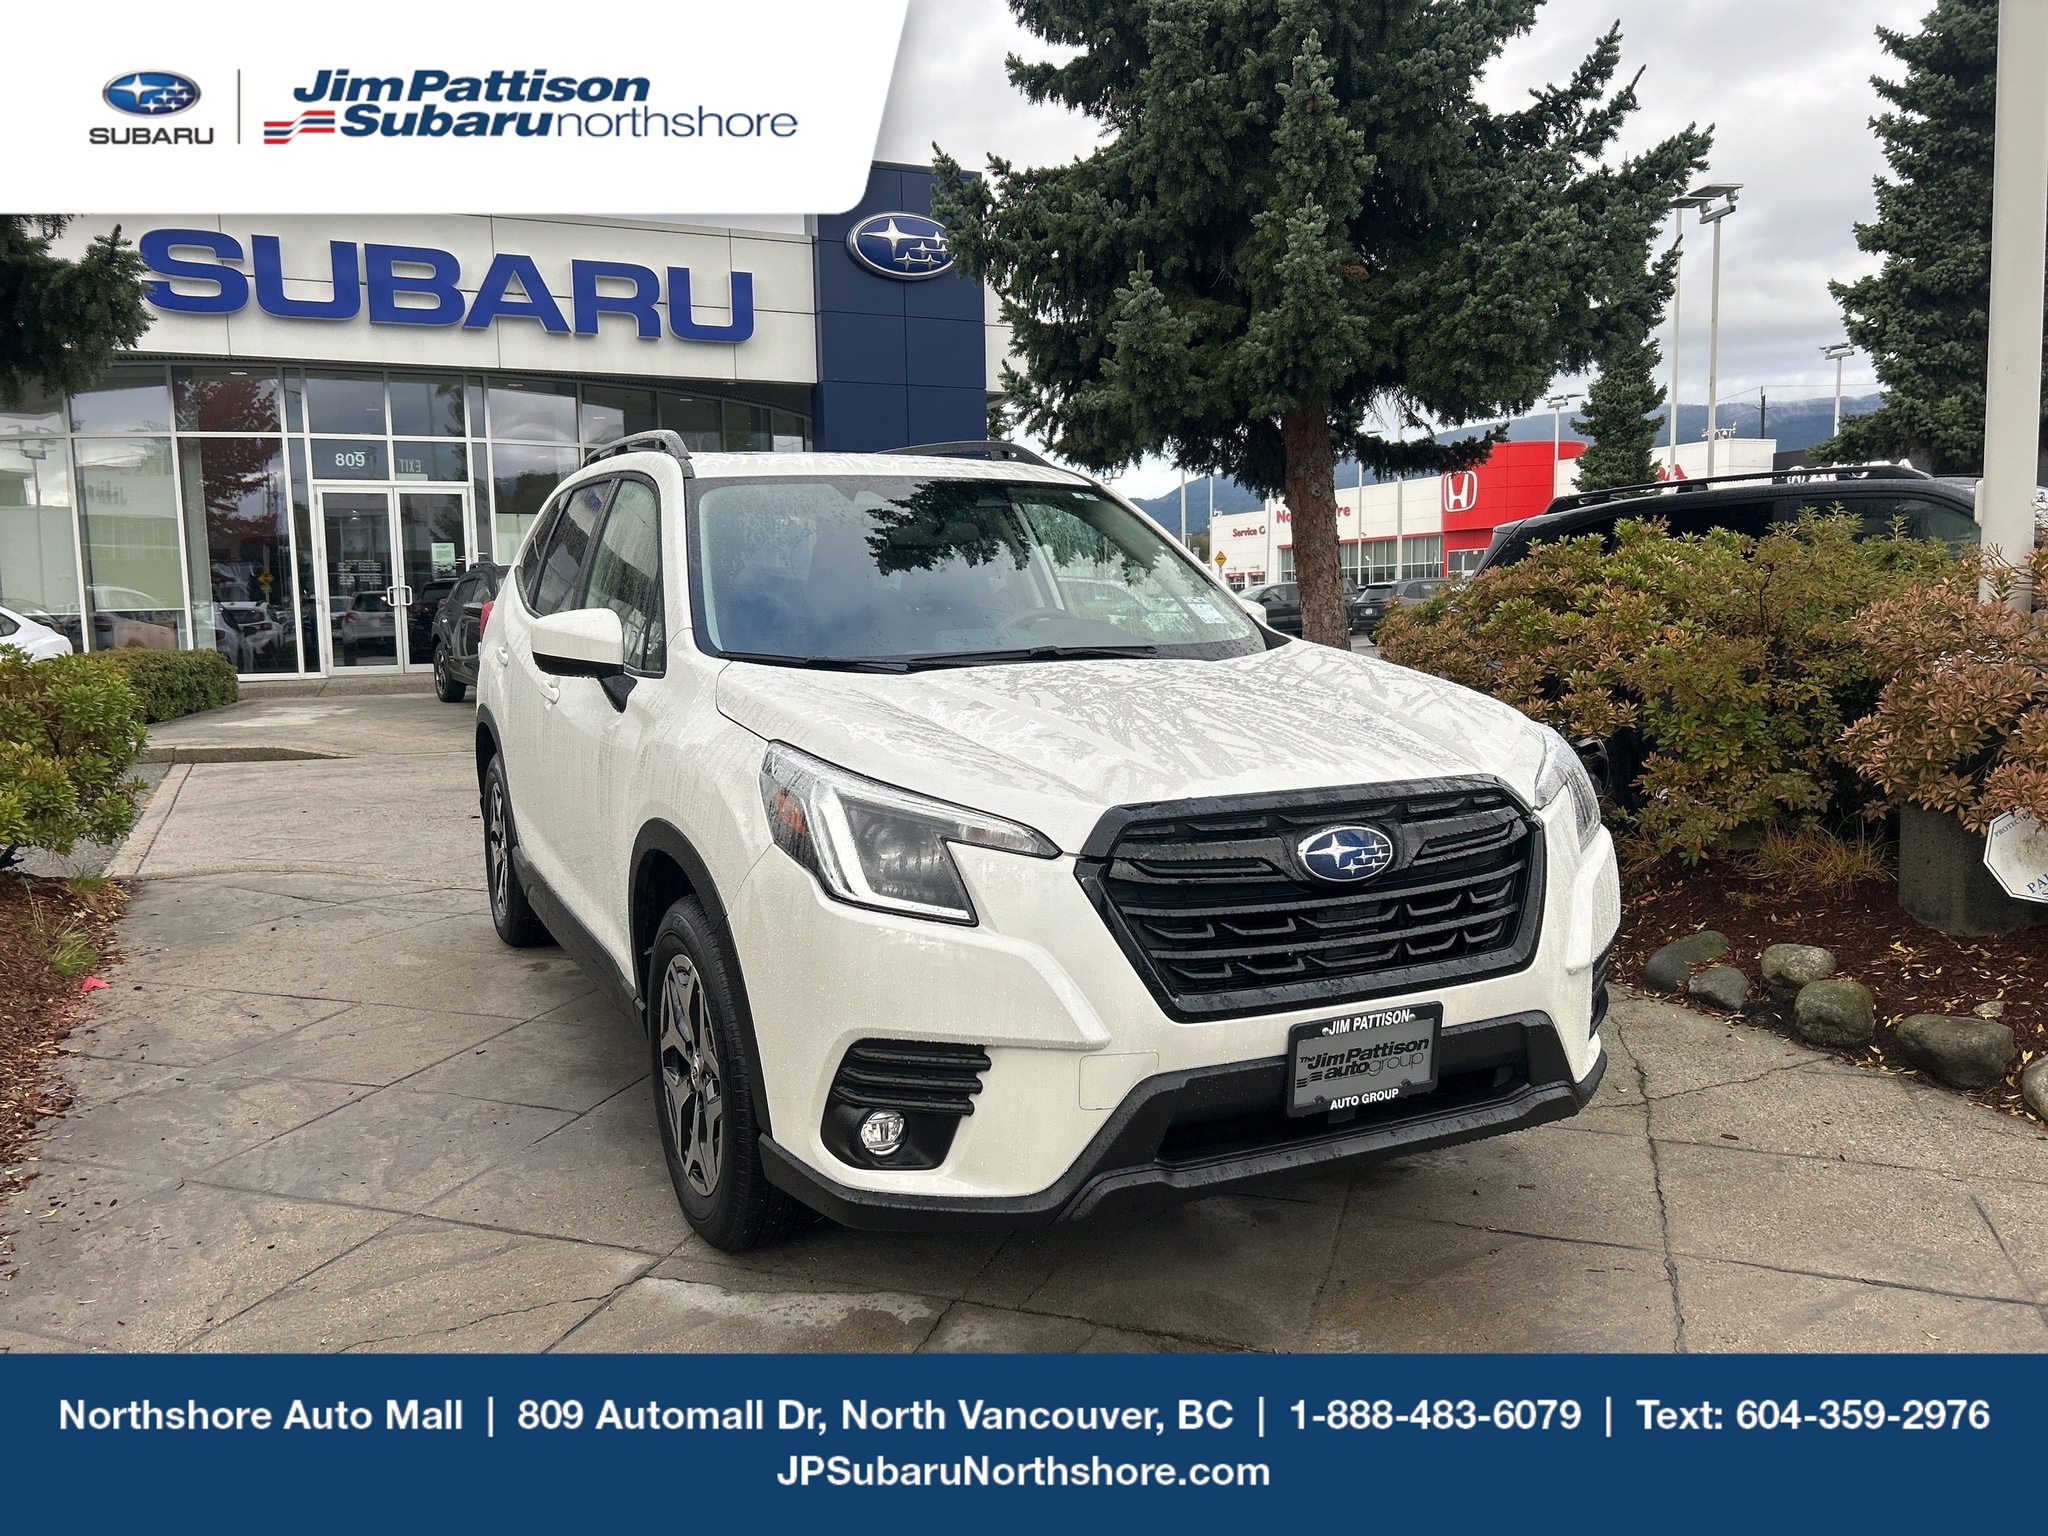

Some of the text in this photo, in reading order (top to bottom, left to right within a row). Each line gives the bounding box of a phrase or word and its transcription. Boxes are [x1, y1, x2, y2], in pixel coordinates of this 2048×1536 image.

[140, 227, 755, 344] SUBARU
[335, 452, 365, 467] 809
[1232, 526, 1258, 538] Service
[1329, 1008, 1410, 1035] JIM PATTISON
[1299, 1055, 1316, 1064] The
[1330, 1087, 1399, 1111] AUTO GROUP
